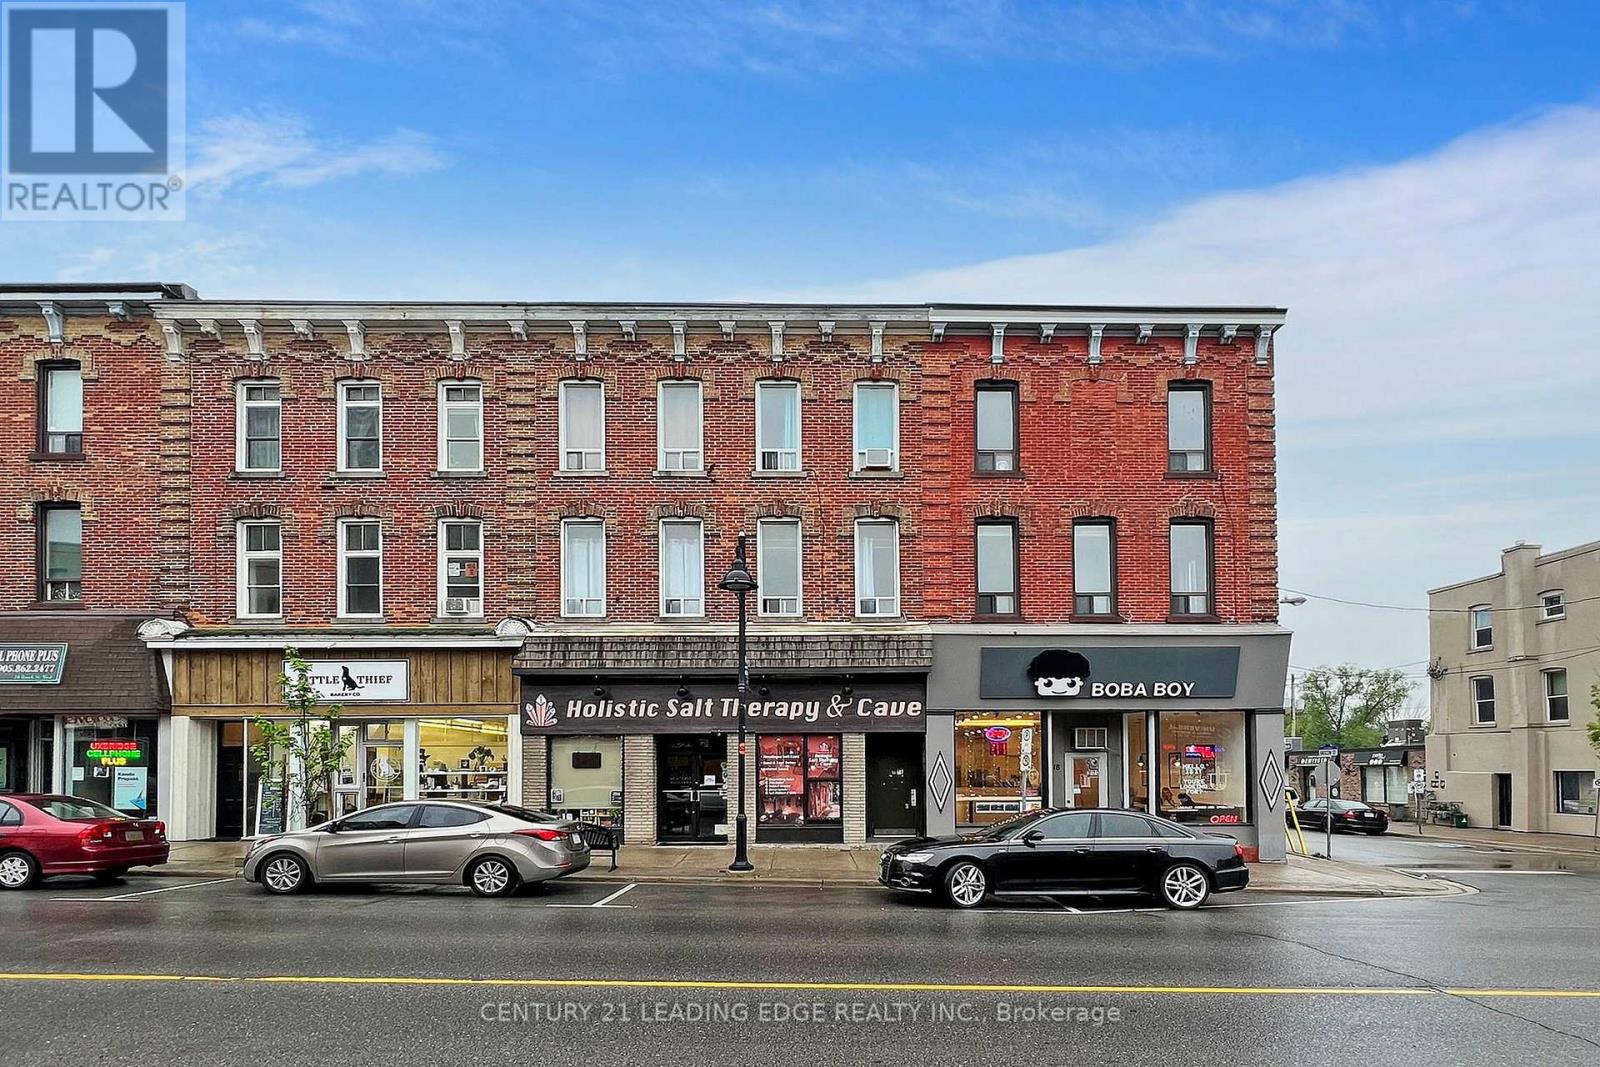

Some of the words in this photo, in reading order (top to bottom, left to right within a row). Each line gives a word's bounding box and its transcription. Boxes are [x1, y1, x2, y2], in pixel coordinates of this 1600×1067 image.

[5, 650, 36, 661] PHONE
[36, 650, 59, 661] PLUS
[356, 675, 393, 684] THIEF
[1091, 682, 1147, 697] BOBA
[1153, 682, 1195, 697] BOY
[566, 699, 659, 718] Holistic
[666, 698, 713, 718] Salt
[826, 694, 852, 718] &
[857, 698, 922, 717] Cave
[90, 742, 137, 750] UXBRIDGE
[86, 750, 141, 758] CELLPHONE
[101, 757, 127, 766] PLUS
[1210, 815, 1238, 823] OPEN
